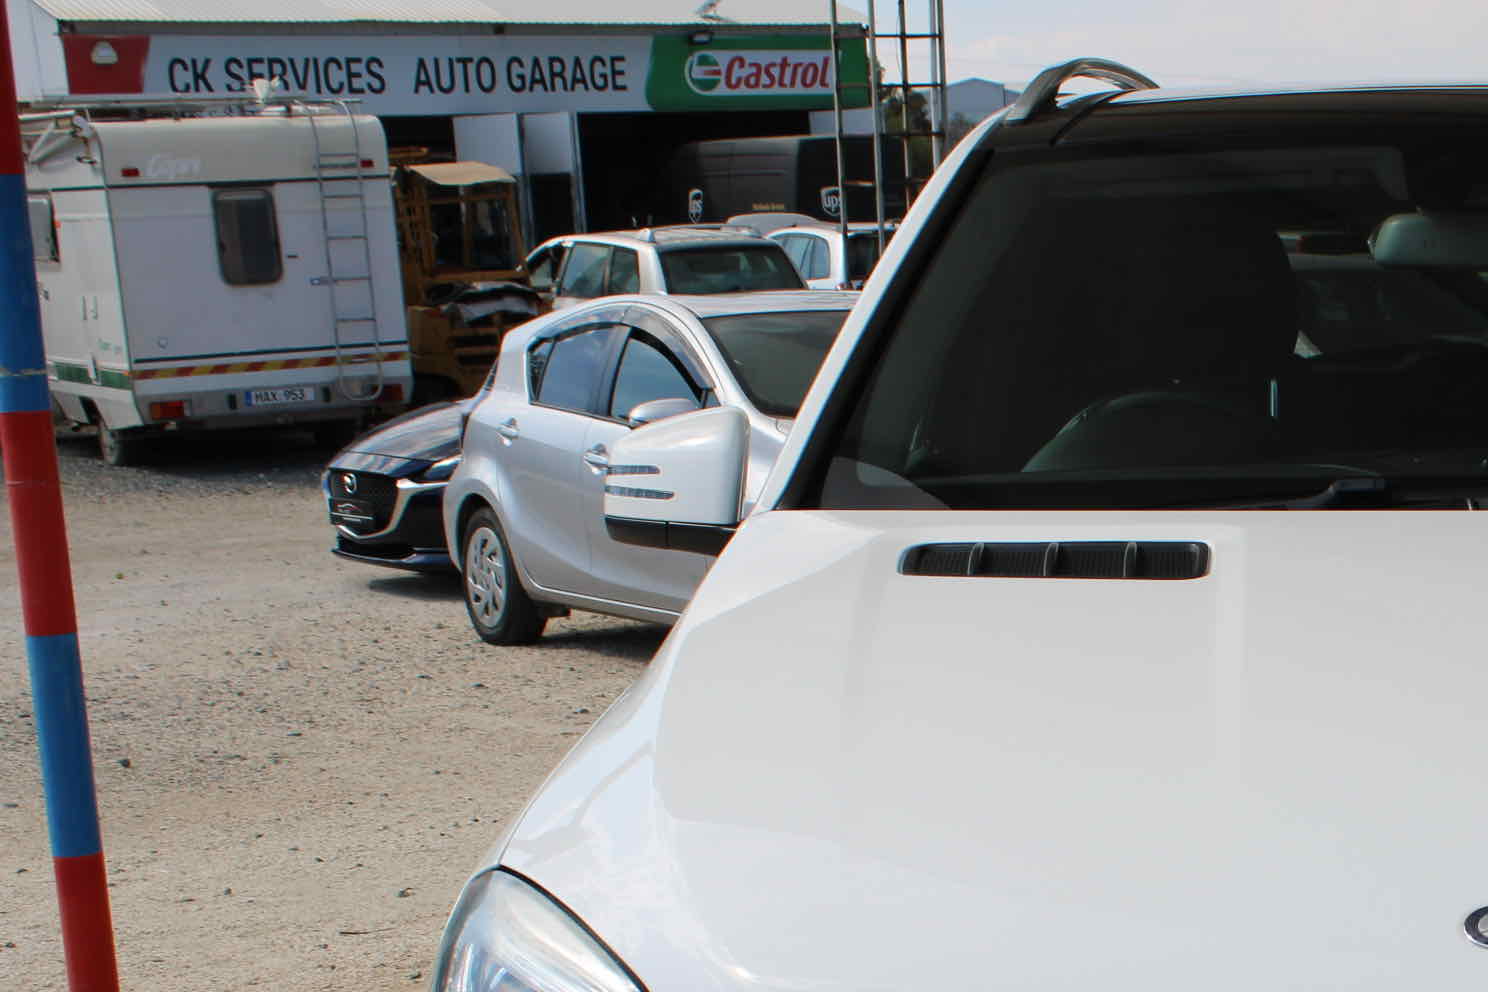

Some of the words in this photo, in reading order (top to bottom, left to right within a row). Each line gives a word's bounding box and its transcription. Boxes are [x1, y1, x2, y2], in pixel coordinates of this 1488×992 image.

[168, 57, 214, 93] CK
[224, 56, 386, 95] SERVICES
[414, 56, 497, 94] AUTO
[506, 55, 628, 93] GARAGE
[725, 56, 830, 90] Castrol
